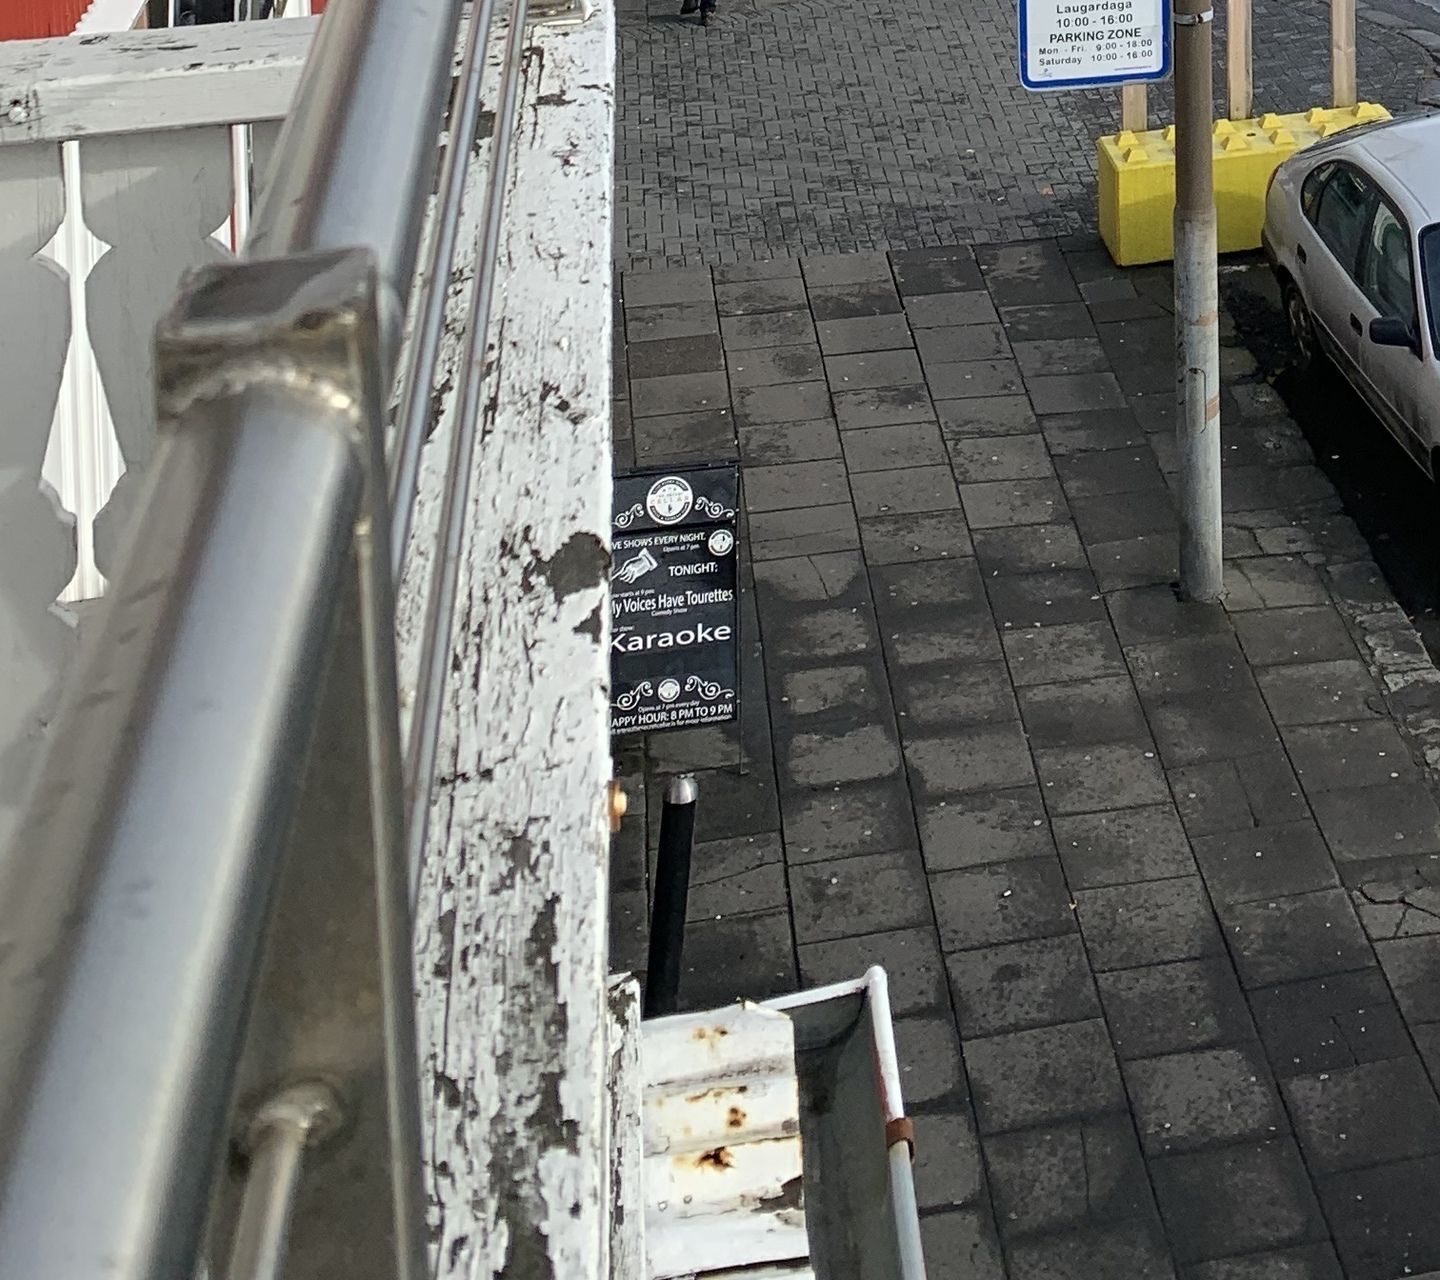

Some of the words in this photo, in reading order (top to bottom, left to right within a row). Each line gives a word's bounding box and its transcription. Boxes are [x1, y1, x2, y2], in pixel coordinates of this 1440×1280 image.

[1056, 1, 1132, 16] Laugardaga
[1057, 17, 1089, 28] 10:00
[1101, 14, 1133, 26] 16:00
[1050, 30, 1105, 44] PARKING
[1108, 27, 1142, 40] ZONE
[1096, 43, 1117, 52] 9:00
[1127, 39, 1153, 49] 18:00
[1039, 57, 1082, 66] Saturday
[1091, 53, 1117, 62] 10:00
[1127, 50, 1153, 60] 16:00
[612, 539, 623, 550] VE
[624, 537, 653, 549] SHOWS
[654, 535, 678, 547] EVERY
[679, 532, 706, 544] NIGHT.
[668, 562, 718, 576] TONIGHT:
[623, 597, 656, 613] Voices
[658, 594, 684, 608] Have
[685, 588, 733, 605] Tourettes
[611, 623, 732, 652] Karaoke
[611, 714, 638, 728] APPY
[638, 712, 669, 725] HOUR:
[670, 711, 677, 721] 8
[679, 708, 693, 719] PM
[695, 707, 708, 717] TO
[709, 705, 716, 716] 9
[718, 703, 733, 714] PM
